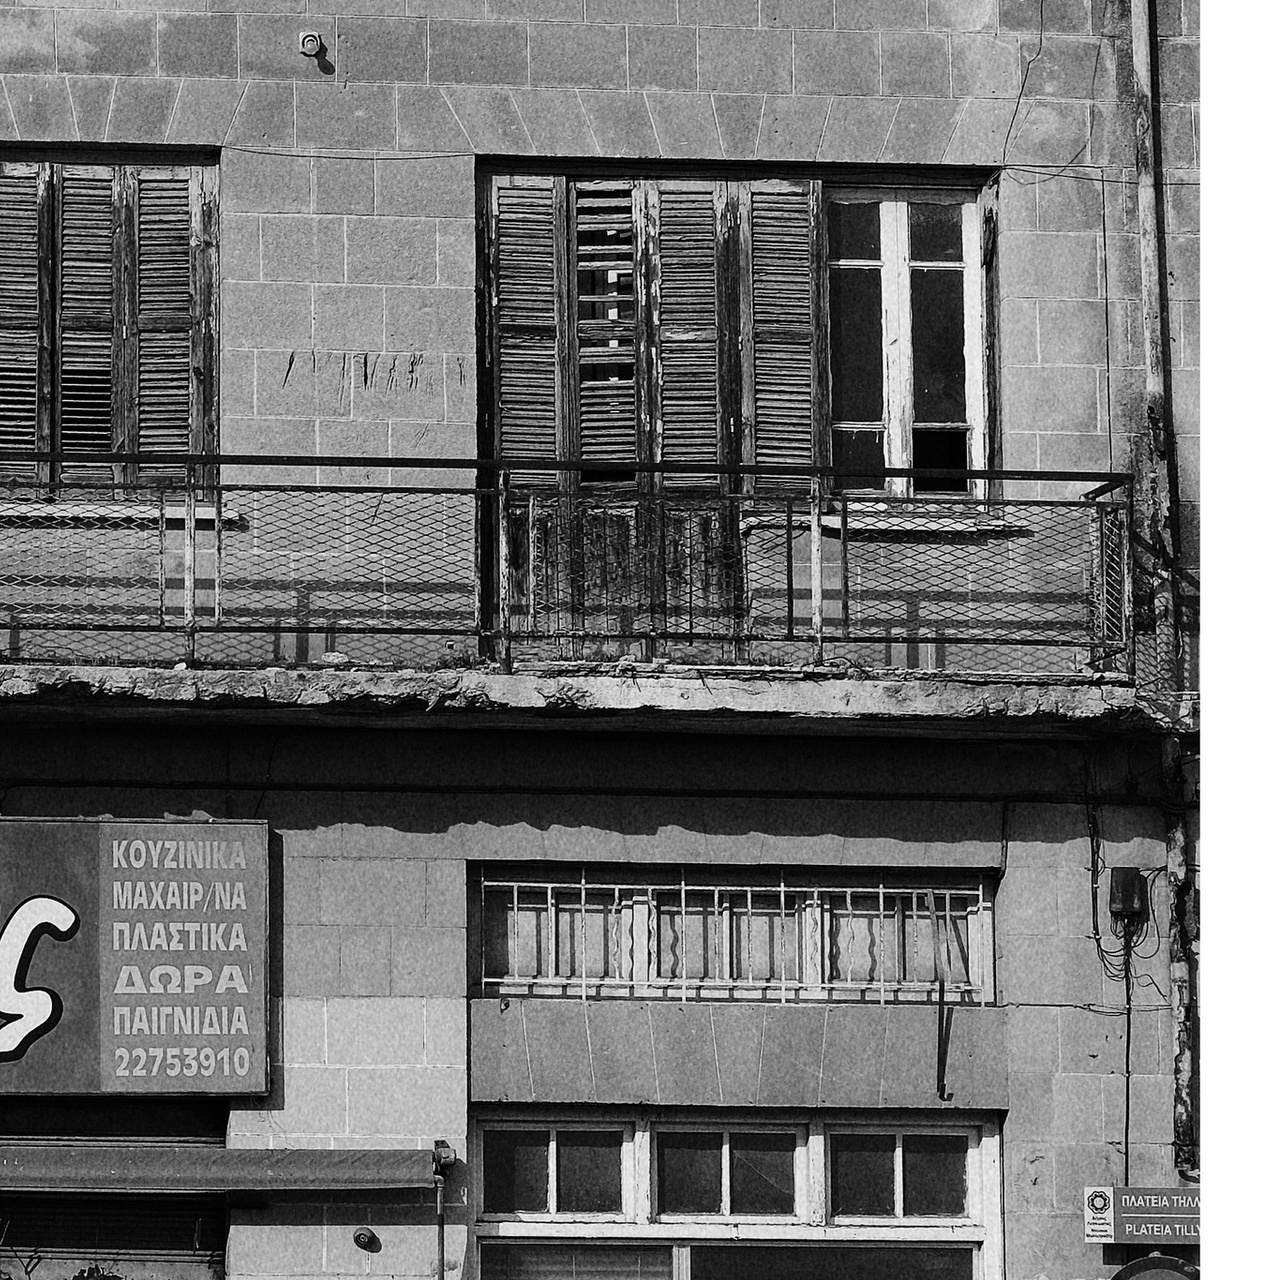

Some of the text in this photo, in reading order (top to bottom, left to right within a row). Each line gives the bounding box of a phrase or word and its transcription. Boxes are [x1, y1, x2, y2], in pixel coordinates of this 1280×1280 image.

[112, 840, 247, 869] ΚΟΥΖΙΝΙΚΑ
[113, 881, 247, 912] ΜΑΧΑΙΡ/ΝΑ
[113, 922, 248, 951] ΠΛΑΣΤΙΚΑ
[113, 965, 249, 994] ΔΩΡΑ
[113, 1006, 249, 1035] ΠΑΙΓΝΙΔΙΑ
[114, 1047, 250, 1077] 22753910
[1121, 1195, 1169, 1207] ΠΛΑΤΕΙΑ
[1125, 1223, 1172, 1235] PLATEIA
